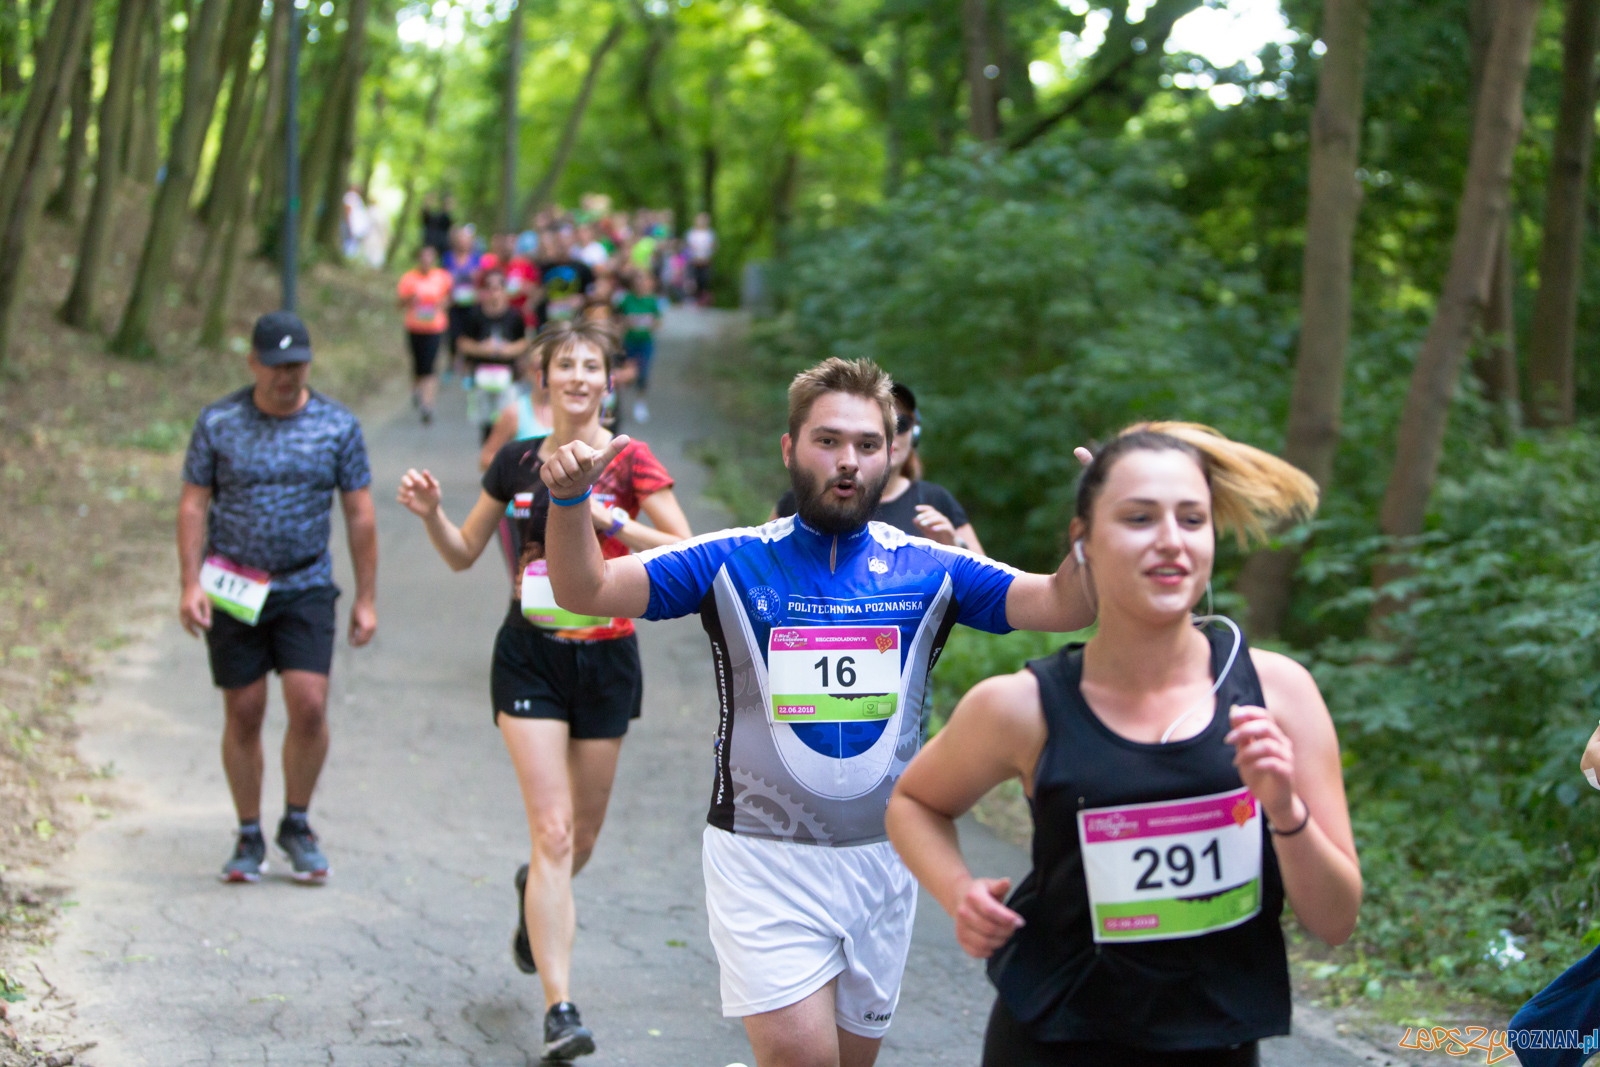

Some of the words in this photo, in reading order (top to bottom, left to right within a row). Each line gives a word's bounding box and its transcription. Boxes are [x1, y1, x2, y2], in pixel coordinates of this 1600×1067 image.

[214, 574, 249, 597] 417
[788, 601, 862, 614] POLITECHNIKA
[865, 599, 924, 612] POZNAŃSKA
[814, 655, 857, 688] 16
[778, 705, 815, 715] 22.06.2018
[1133, 836, 1222, 890] 291
